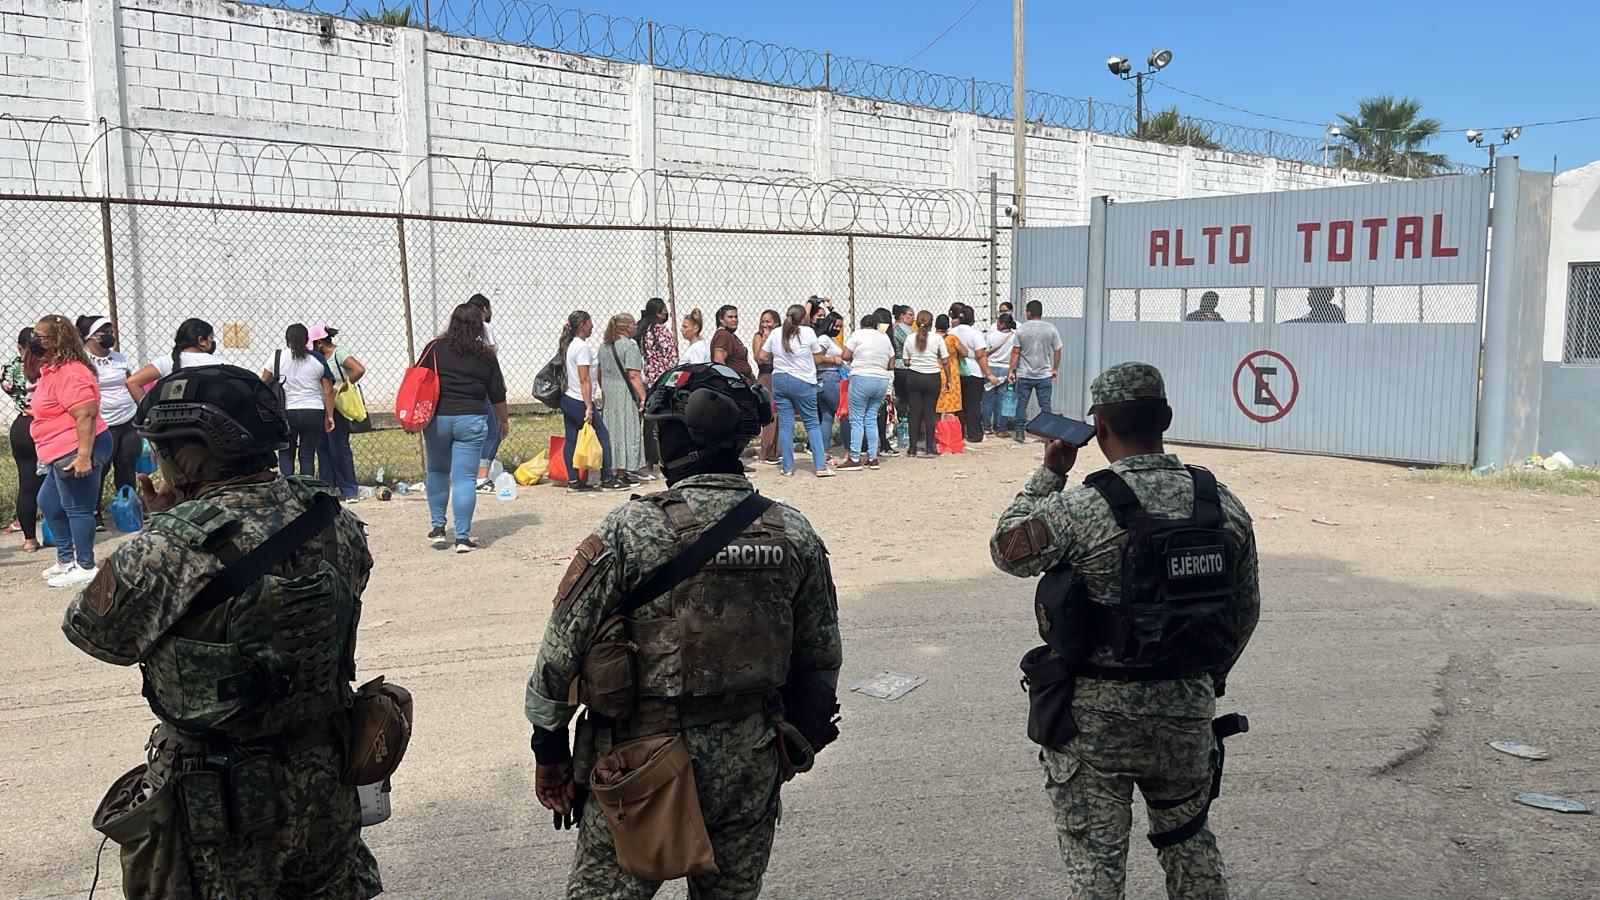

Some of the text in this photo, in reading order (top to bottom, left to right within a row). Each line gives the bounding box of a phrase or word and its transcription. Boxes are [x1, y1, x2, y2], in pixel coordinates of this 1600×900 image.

[1150, 214, 1458, 266] ALTO TOTAL
[1254, 366, 1277, 405] E
[706, 545, 784, 565] ERCITO
[1171, 552, 1223, 576] EJÉRCITO
